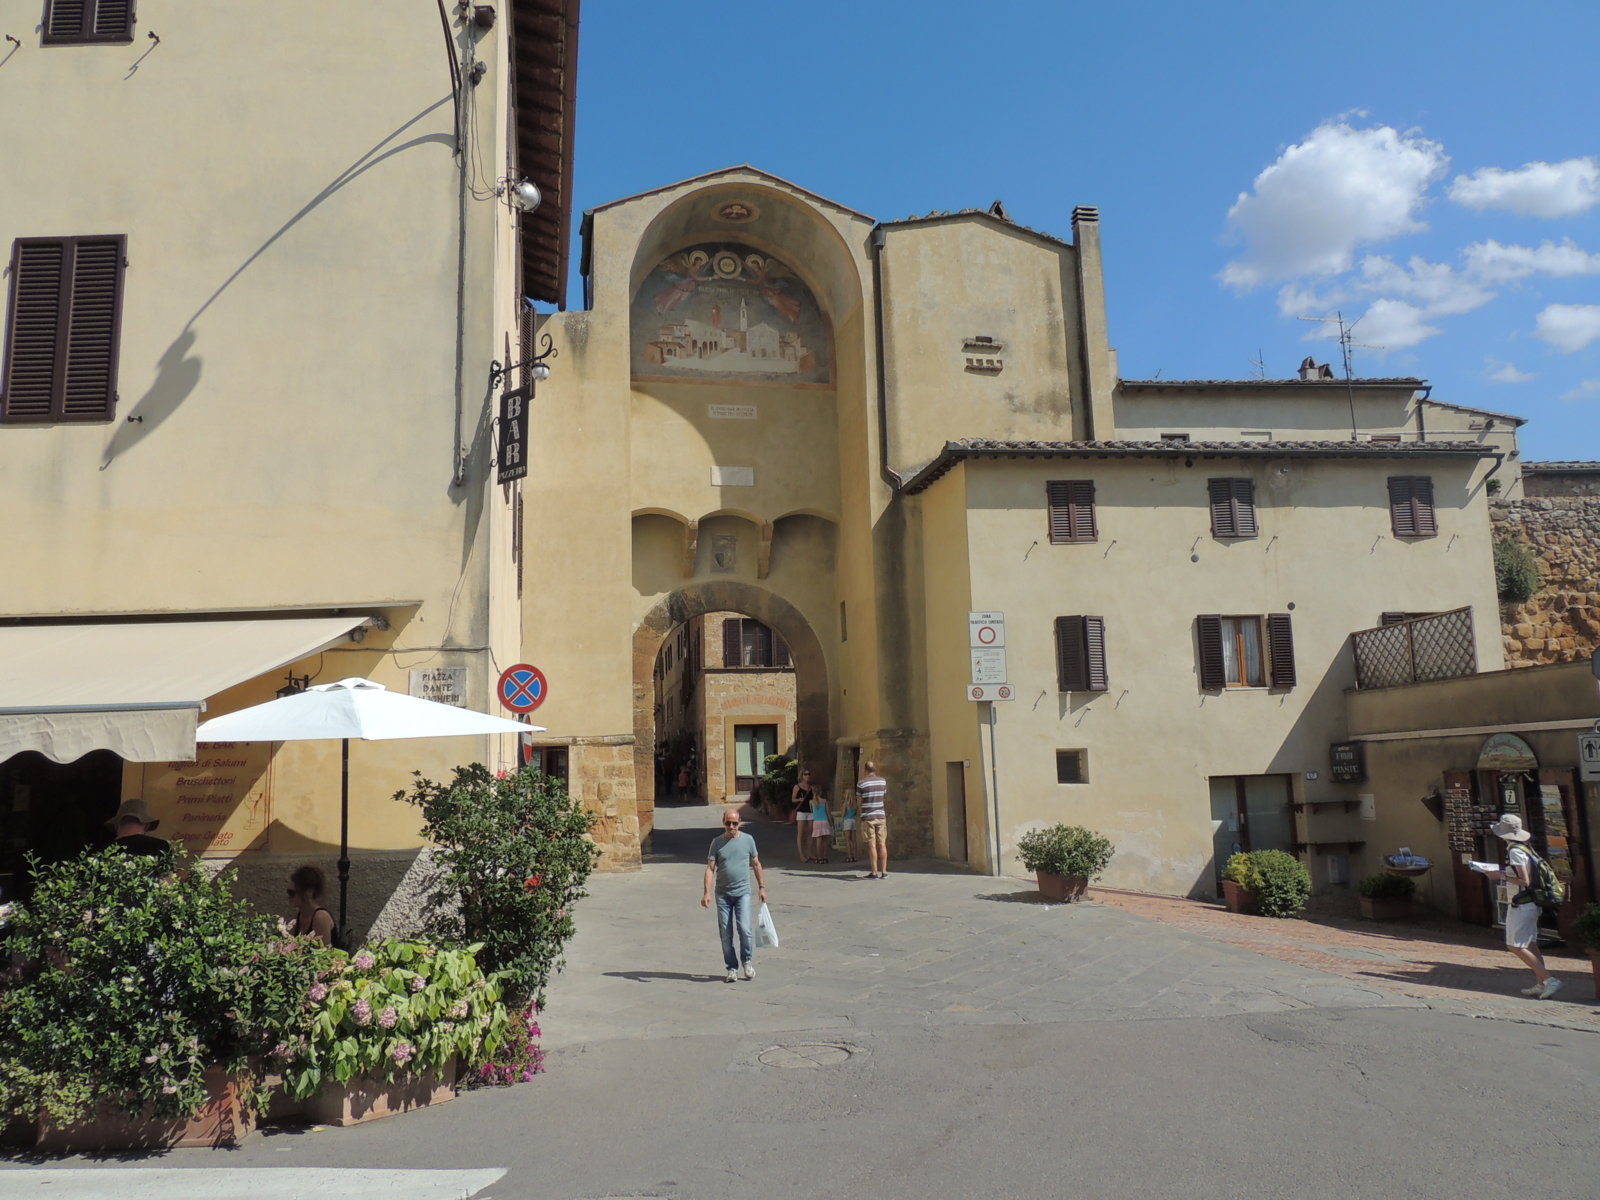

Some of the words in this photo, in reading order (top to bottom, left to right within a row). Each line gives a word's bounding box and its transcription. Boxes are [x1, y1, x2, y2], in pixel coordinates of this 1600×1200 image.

[506, 396, 521, 466] BAR
[499, 465, 526, 480] PIZZERIA
[422, 673, 453, 681] PIAZZA
[423, 684, 453, 692] DANTE
[202, 758, 211, 767] di
[213, 758, 247, 767] Salumi
[176, 776, 236, 785] Bruschettoni
[177, 795, 205, 803] Primi
[206, 794, 233, 803] Piatti
